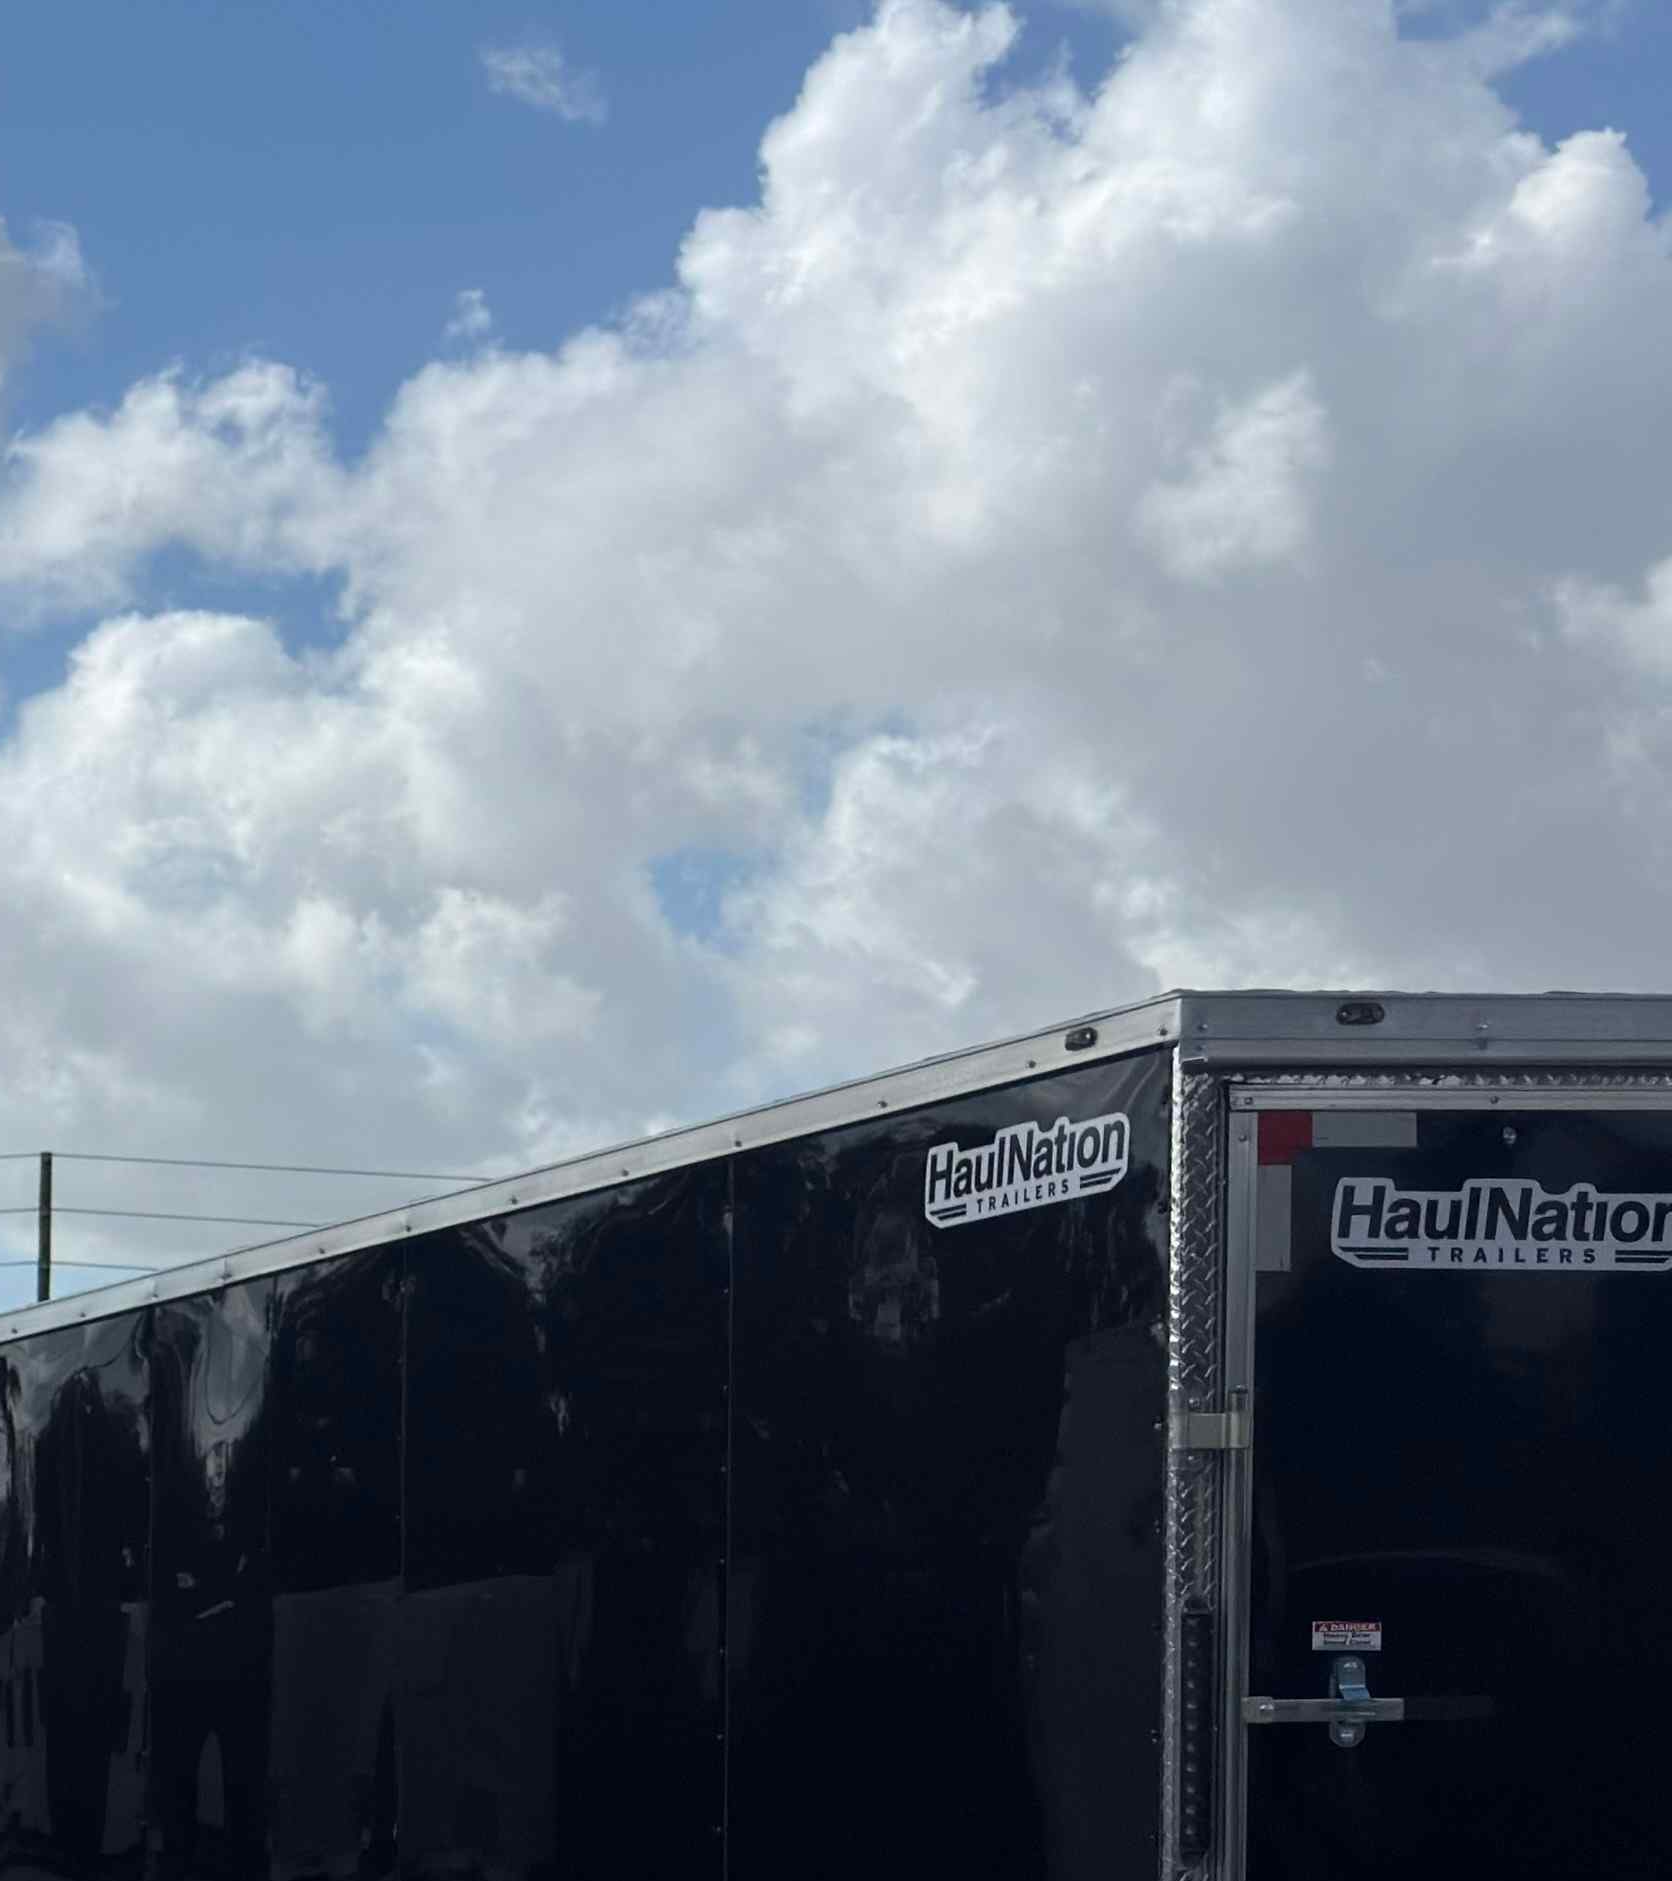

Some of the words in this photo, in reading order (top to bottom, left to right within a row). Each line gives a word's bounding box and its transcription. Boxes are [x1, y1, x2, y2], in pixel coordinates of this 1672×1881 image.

[928, 1118, 1126, 1204] HaulNation
[977, 1178, 1070, 1213] TRAILERS
[1427, 1246, 1596, 1264] TRAILERS
